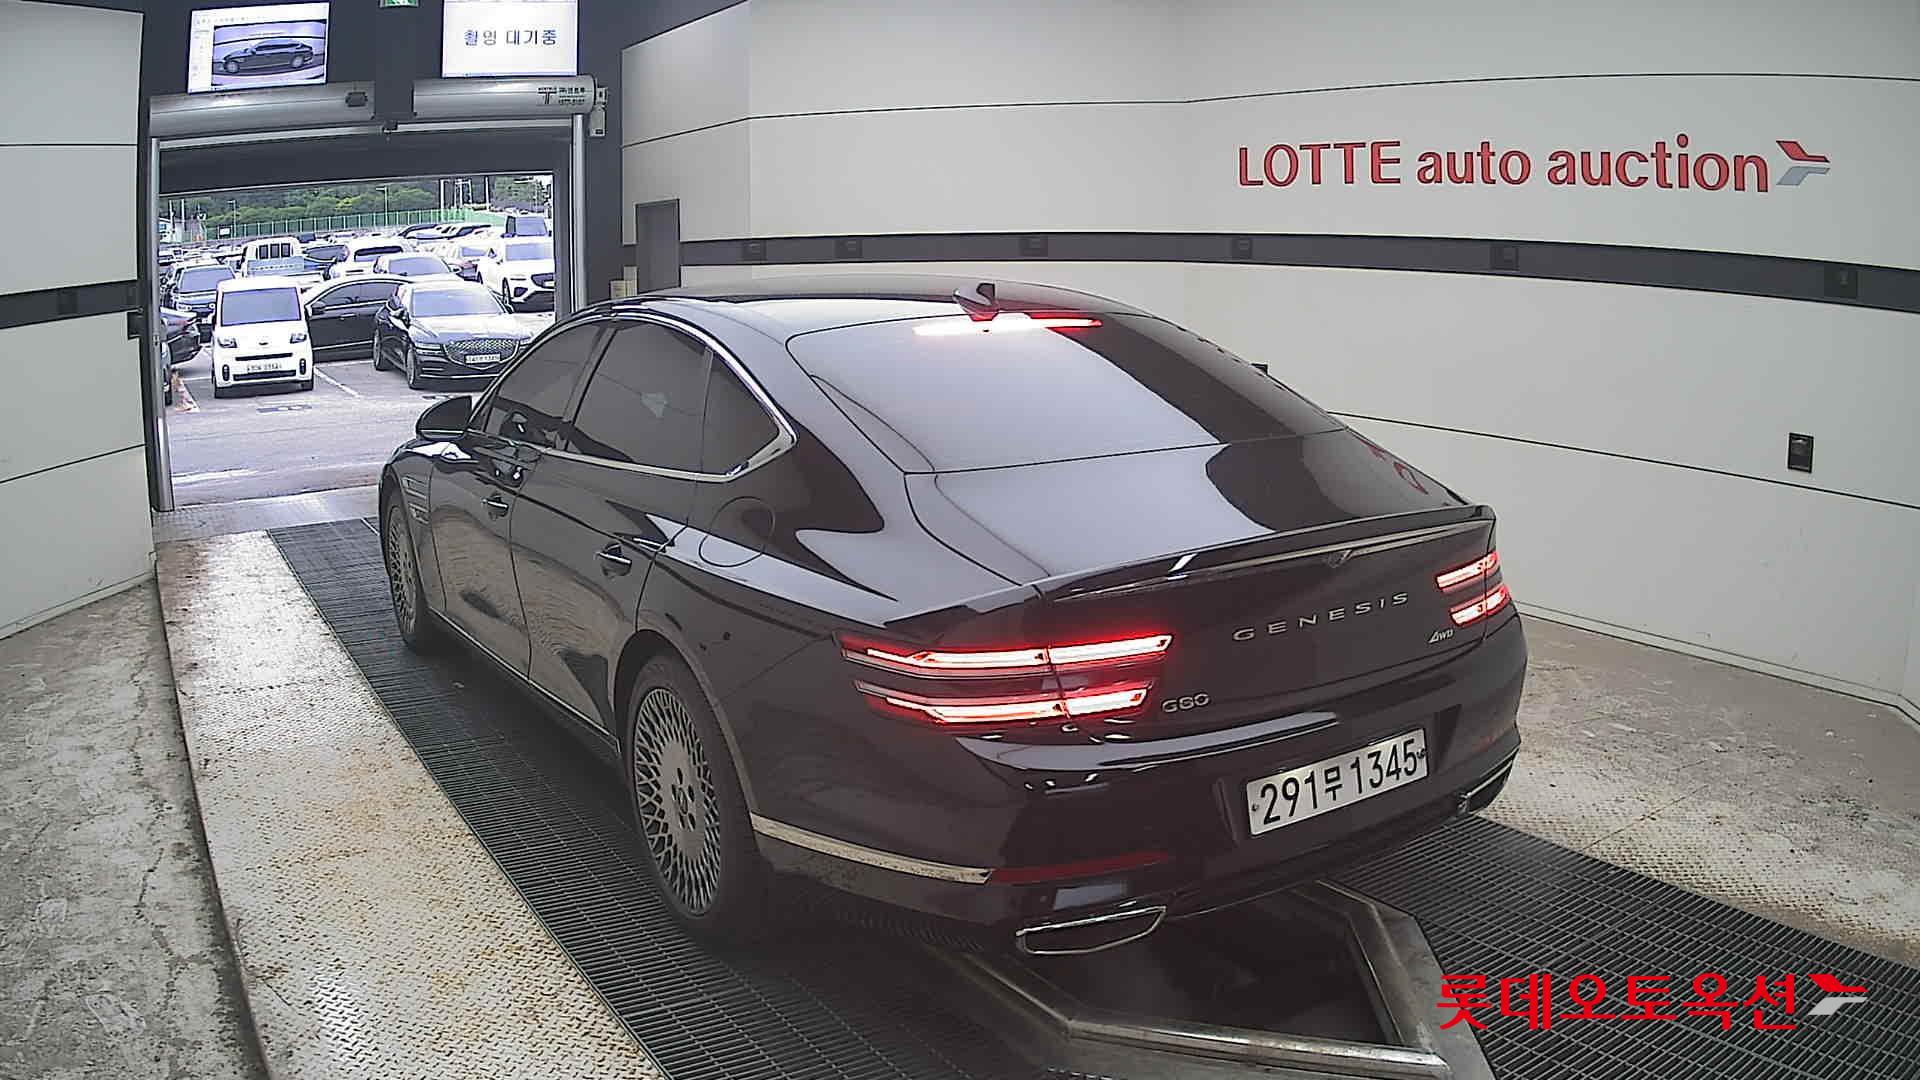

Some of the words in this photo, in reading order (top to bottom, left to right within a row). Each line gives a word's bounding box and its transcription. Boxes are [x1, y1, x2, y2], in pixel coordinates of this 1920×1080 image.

[506, 29, 557, 46] 대기중
[1239, 141, 1401, 187] LOTTE
[1417, 141, 1532, 185] auto
[1547, 134, 1769, 192] auction
[1232, 592, 1409, 642] GENESIS
[1162, 693, 1210, 713] G80
